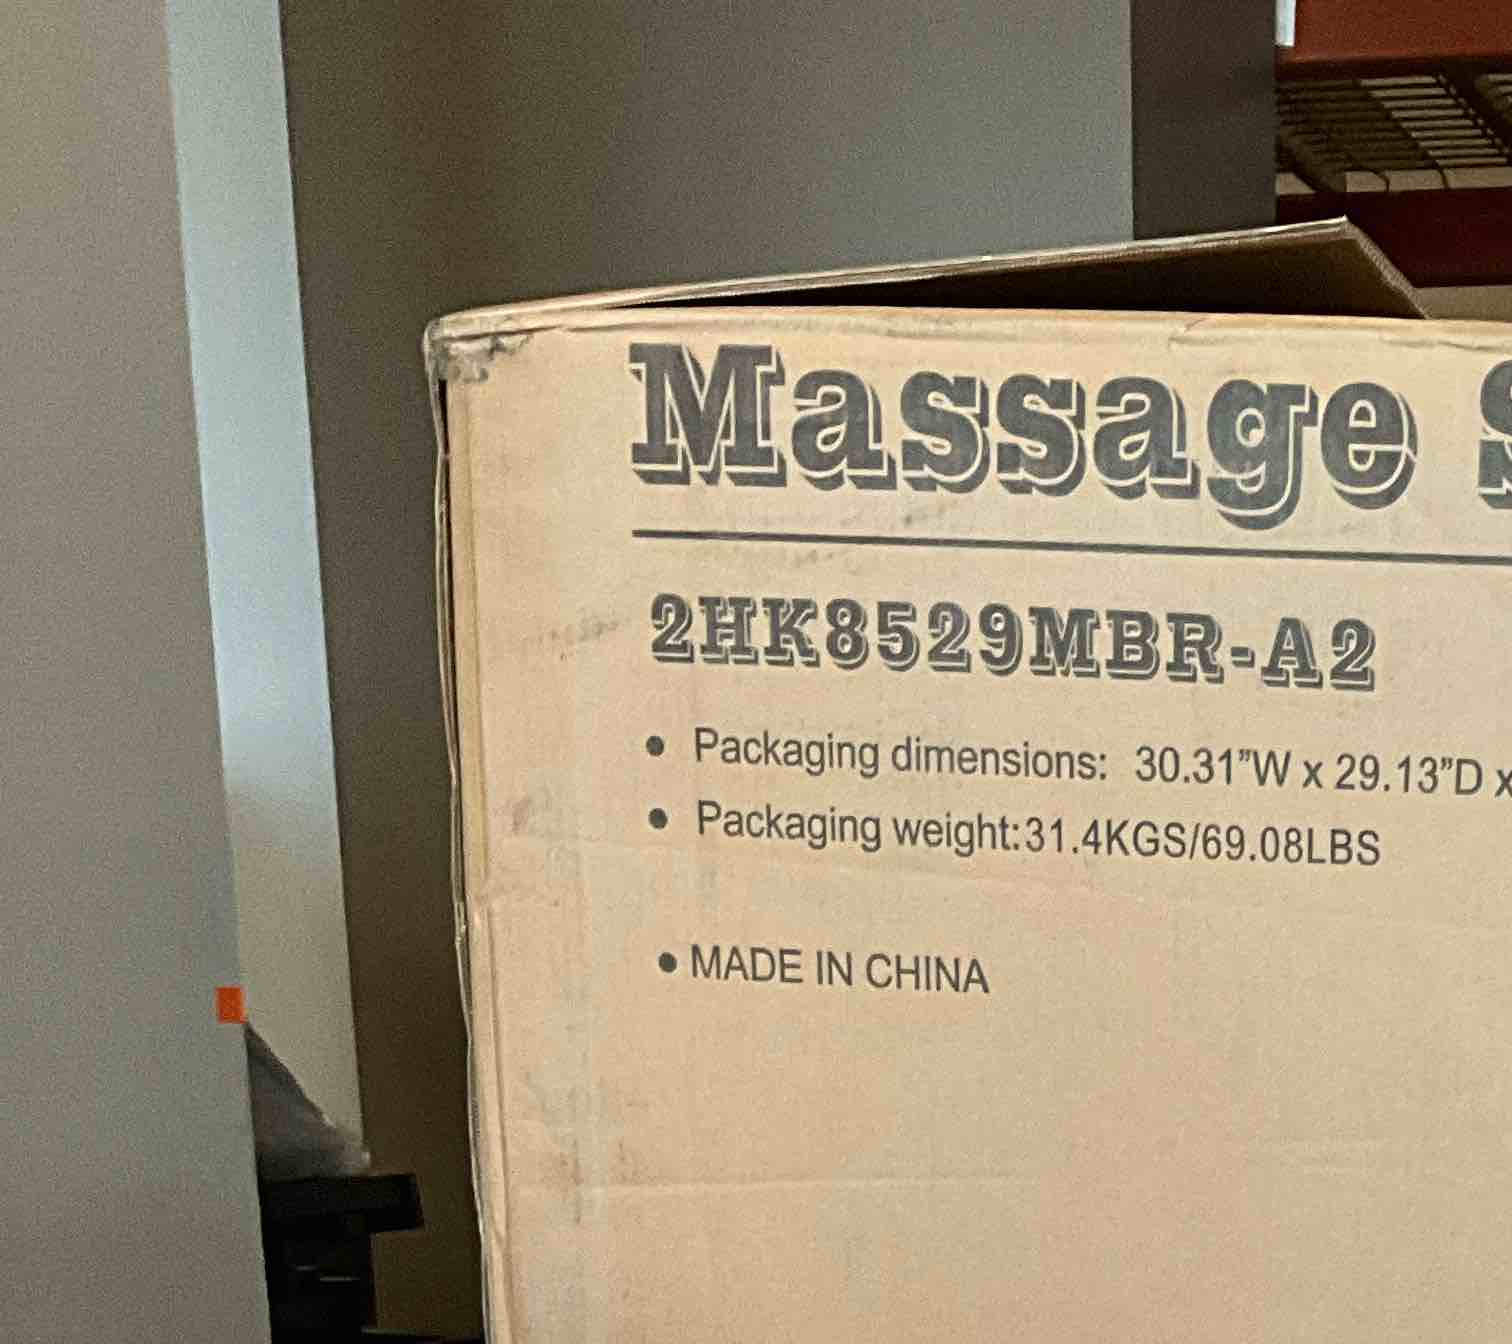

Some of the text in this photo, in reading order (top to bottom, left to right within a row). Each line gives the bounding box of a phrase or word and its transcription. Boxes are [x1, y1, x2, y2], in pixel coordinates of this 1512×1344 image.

[629, 343, 1417, 528] Massage
[650, 594, 1377, 691] 2HK8529MBR-A2
[692, 727, 882, 780] Packaging
[889, 734, 1109, 781] dimensions:
[1302, 759, 1323, 789] x
[696, 801, 1382, 868] Packaging weight:31.4KGS/69.08LBS
[690, 944, 991, 997] MADE IN CHINA
